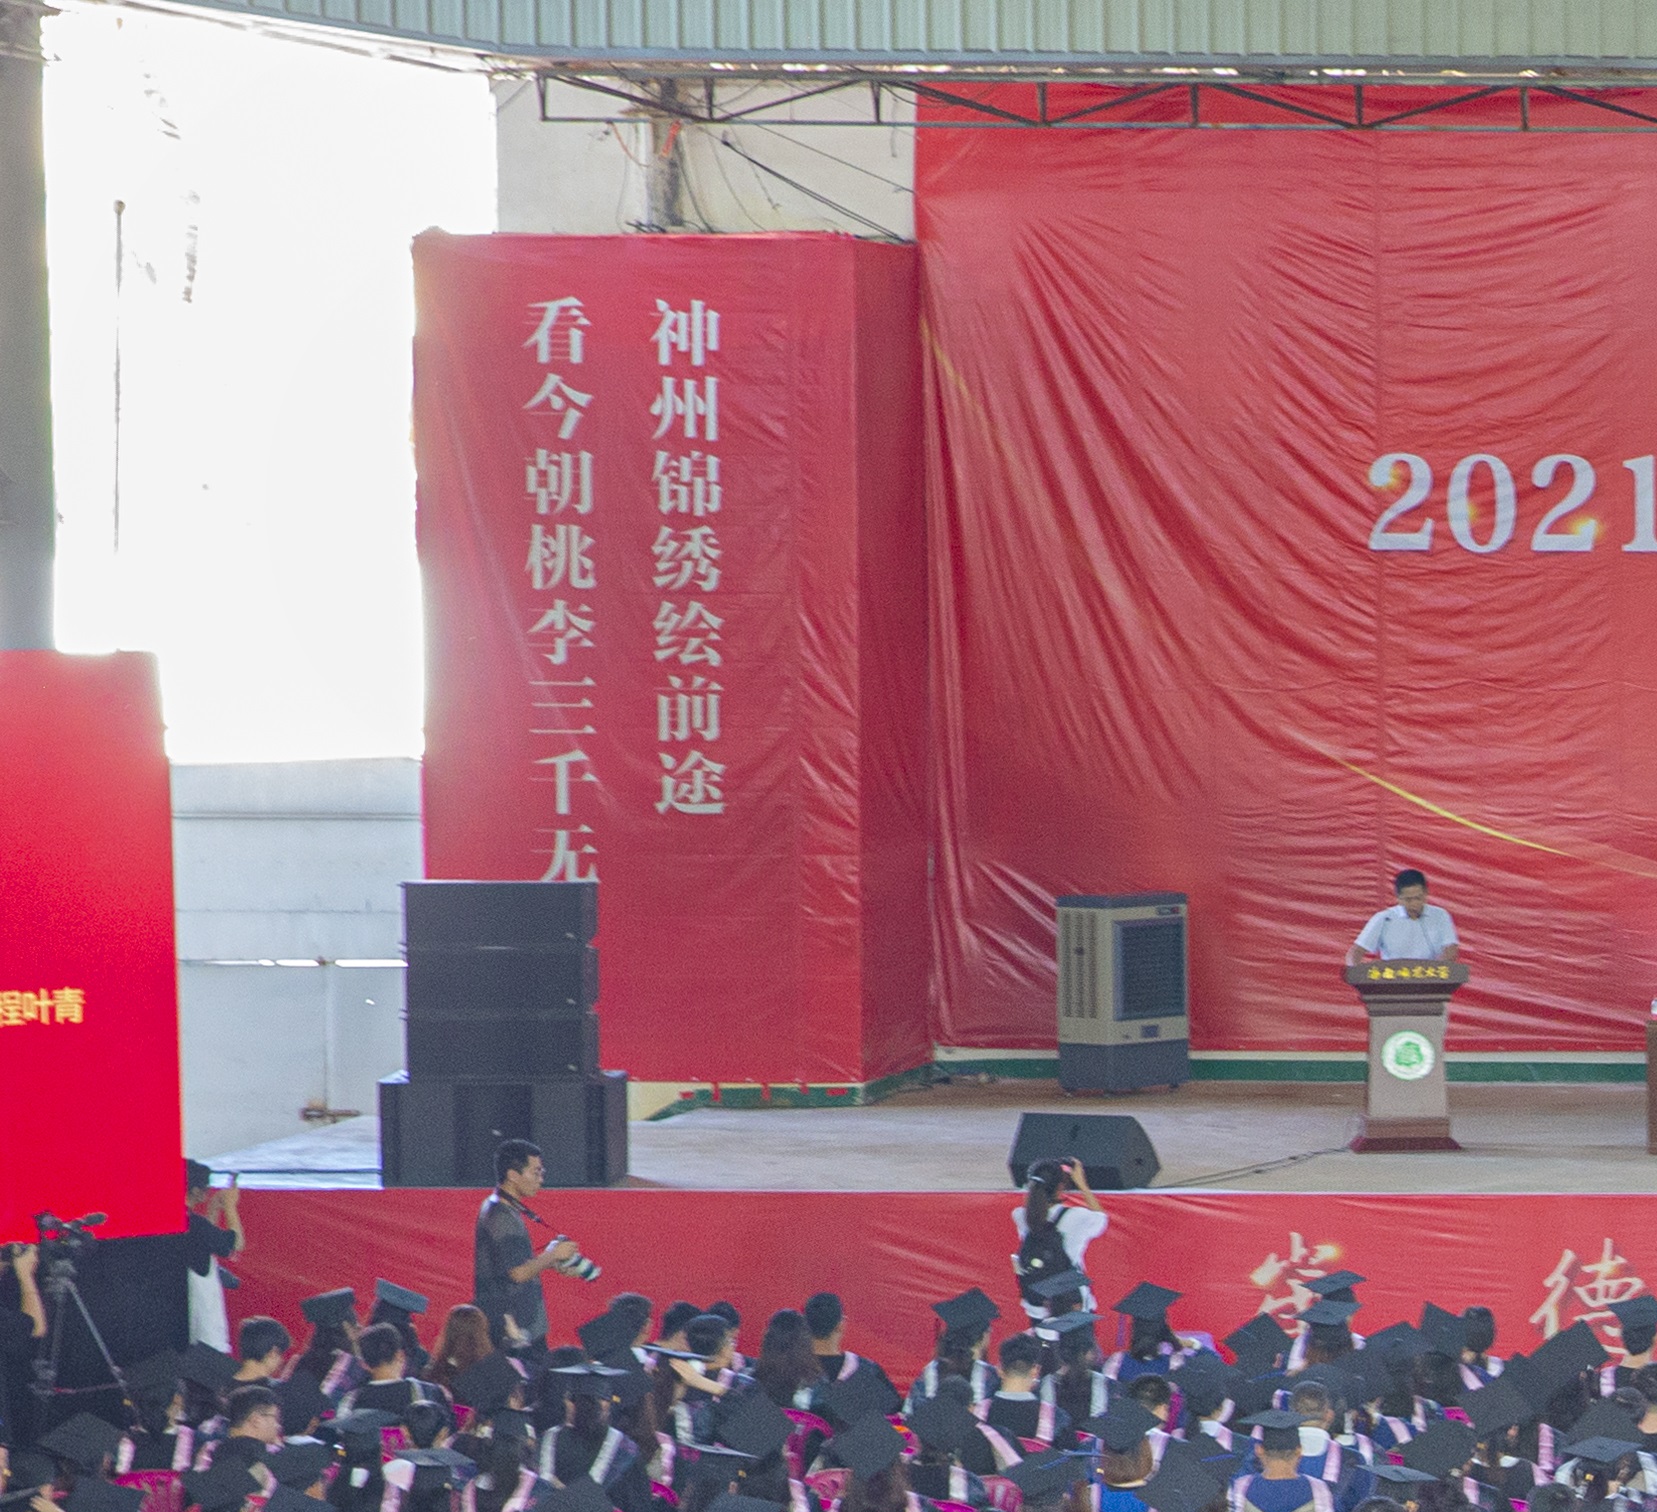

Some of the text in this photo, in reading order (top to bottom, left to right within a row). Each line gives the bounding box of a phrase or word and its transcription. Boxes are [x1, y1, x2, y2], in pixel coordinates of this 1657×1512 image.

[523, 296, 599, 883] 看今朝桃李三千无
[650, 298, 726, 814] 神州锦绣绘前途
